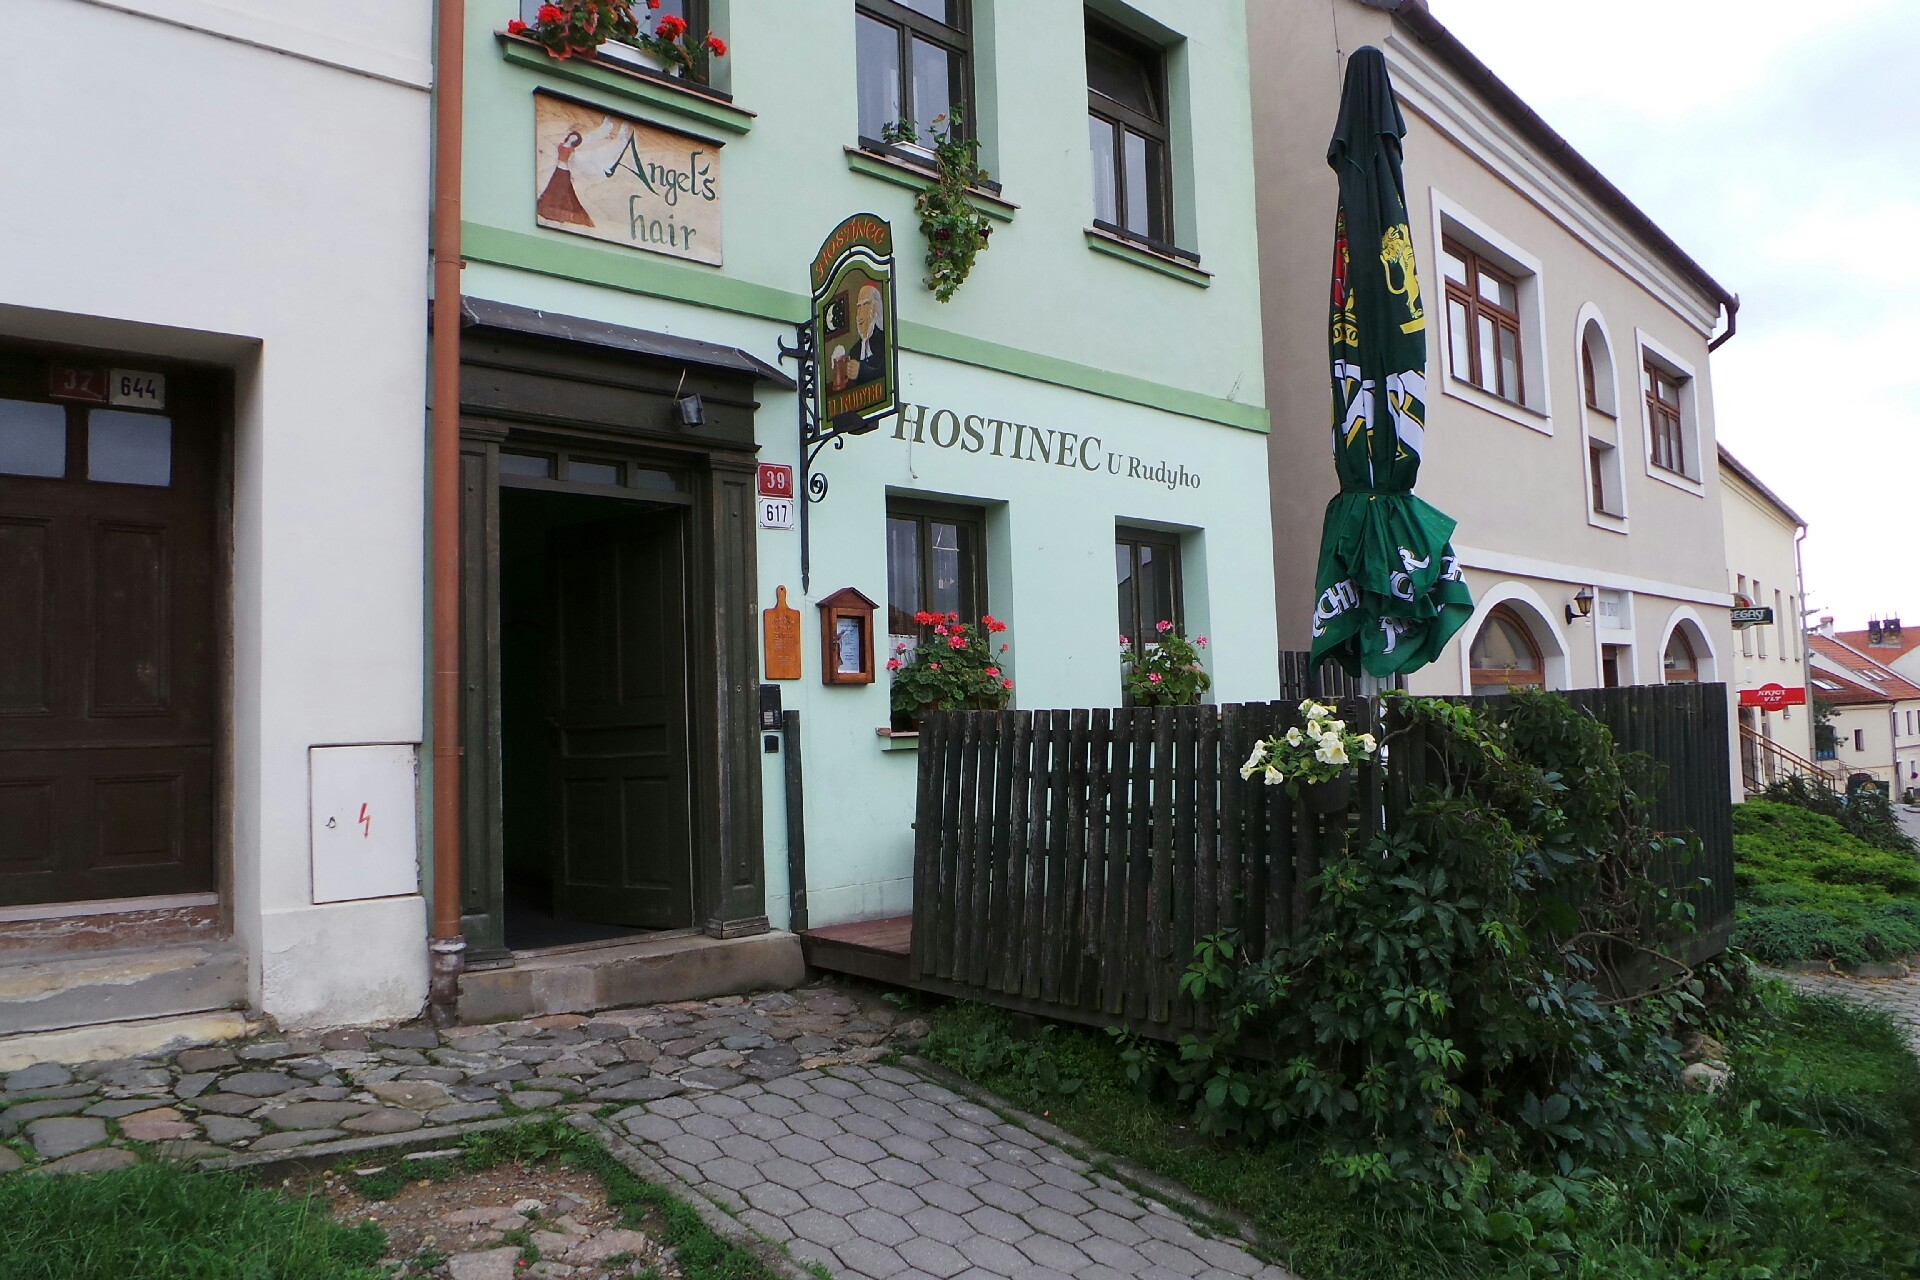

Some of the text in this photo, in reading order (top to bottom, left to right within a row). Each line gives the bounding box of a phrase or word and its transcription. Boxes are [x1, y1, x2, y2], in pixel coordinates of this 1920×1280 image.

[604, 130, 716, 206] Angel's
[629, 194, 697, 250] hair
[120, 376, 156, 400] 644
[890, 402, 1200, 491] HOSTINEC U Rudyho
[766, 470, 785, 489] 39
[766, 504, 787, 523] 617
